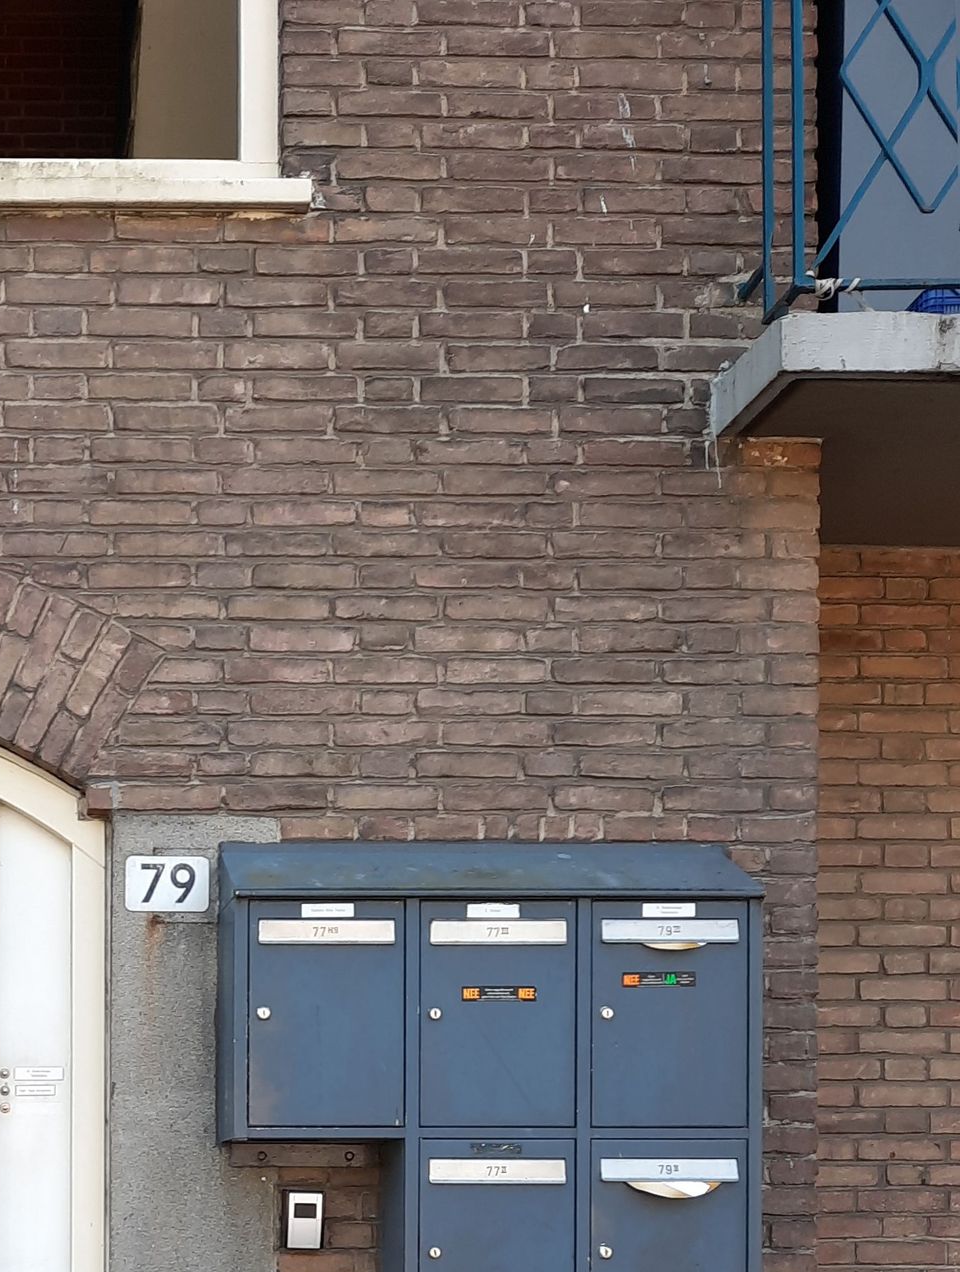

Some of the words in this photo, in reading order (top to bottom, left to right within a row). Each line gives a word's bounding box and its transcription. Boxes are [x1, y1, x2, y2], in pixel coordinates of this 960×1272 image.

[140, 862, 196, 904] 79
[664, 973, 677, 985] JA
[462, 987, 480, 999] NEE
[518, 987, 536, 999] NEE
